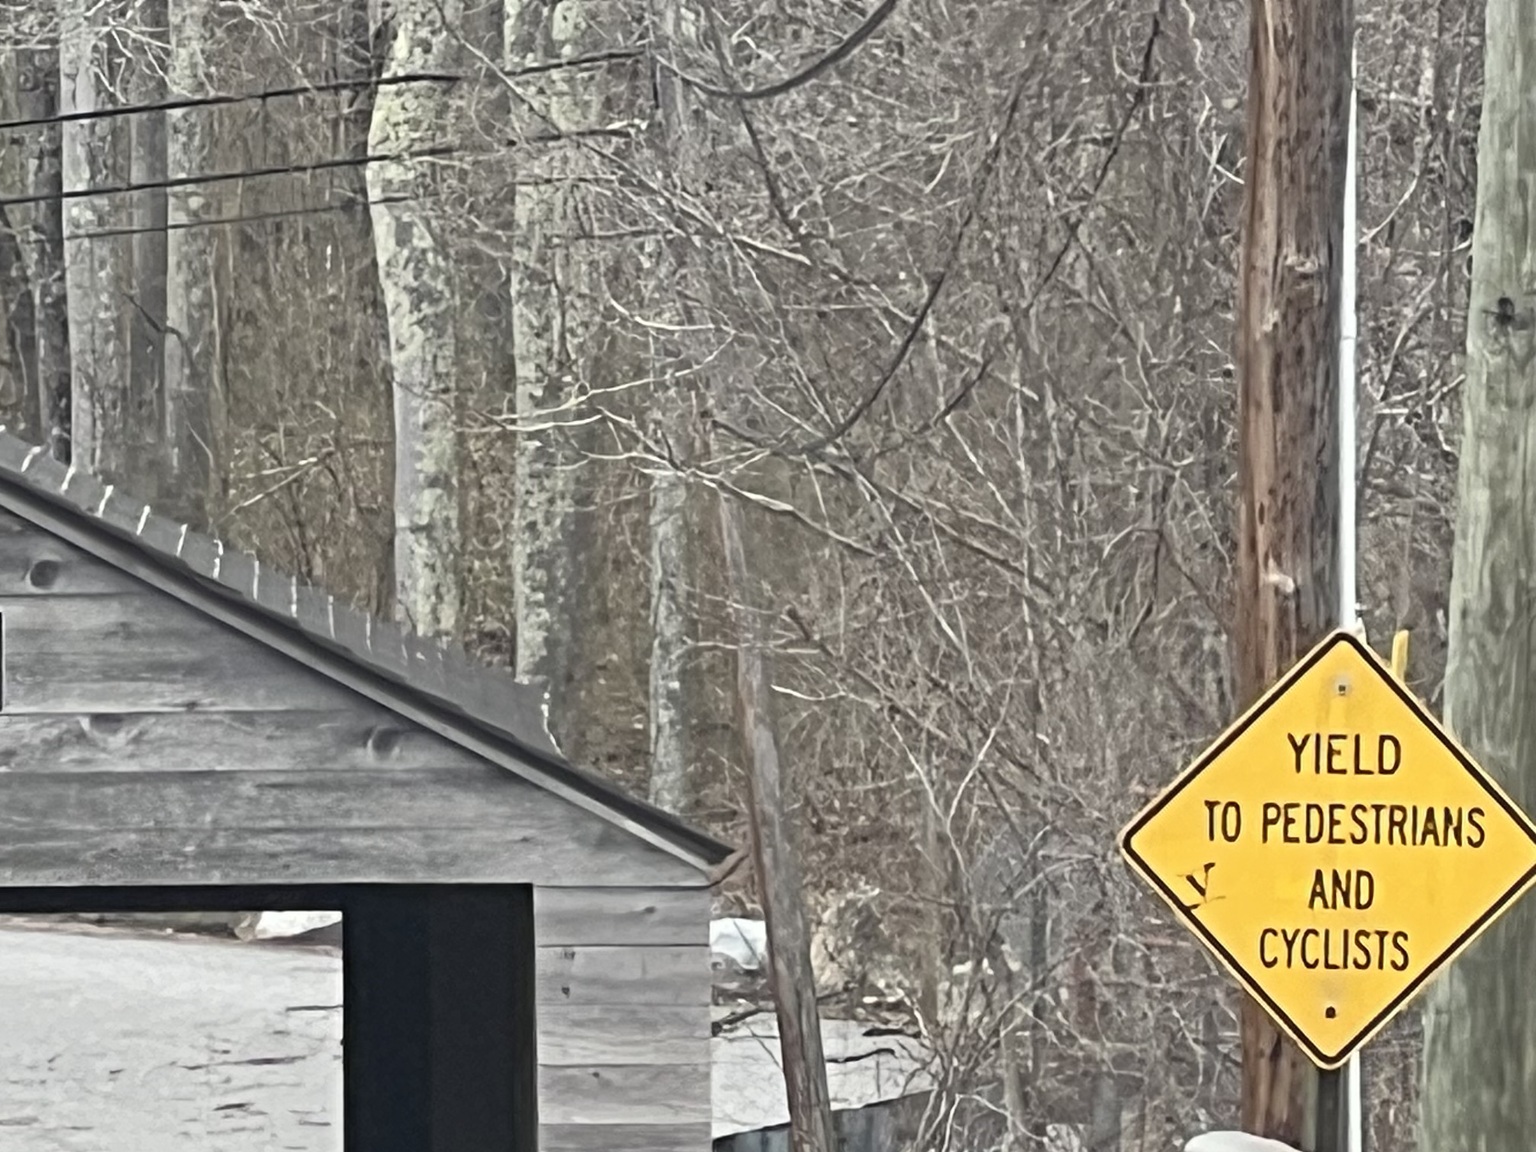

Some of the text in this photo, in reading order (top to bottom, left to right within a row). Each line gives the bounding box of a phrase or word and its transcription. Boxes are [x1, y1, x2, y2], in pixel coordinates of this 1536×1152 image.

[1287, 733, 1402, 775] YIELD
[1204, 800, 1486, 848] TO PEDESTRIANS
[1308, 869, 1375, 910] AND
[1259, 928, 1410, 972] CYCLISTS
